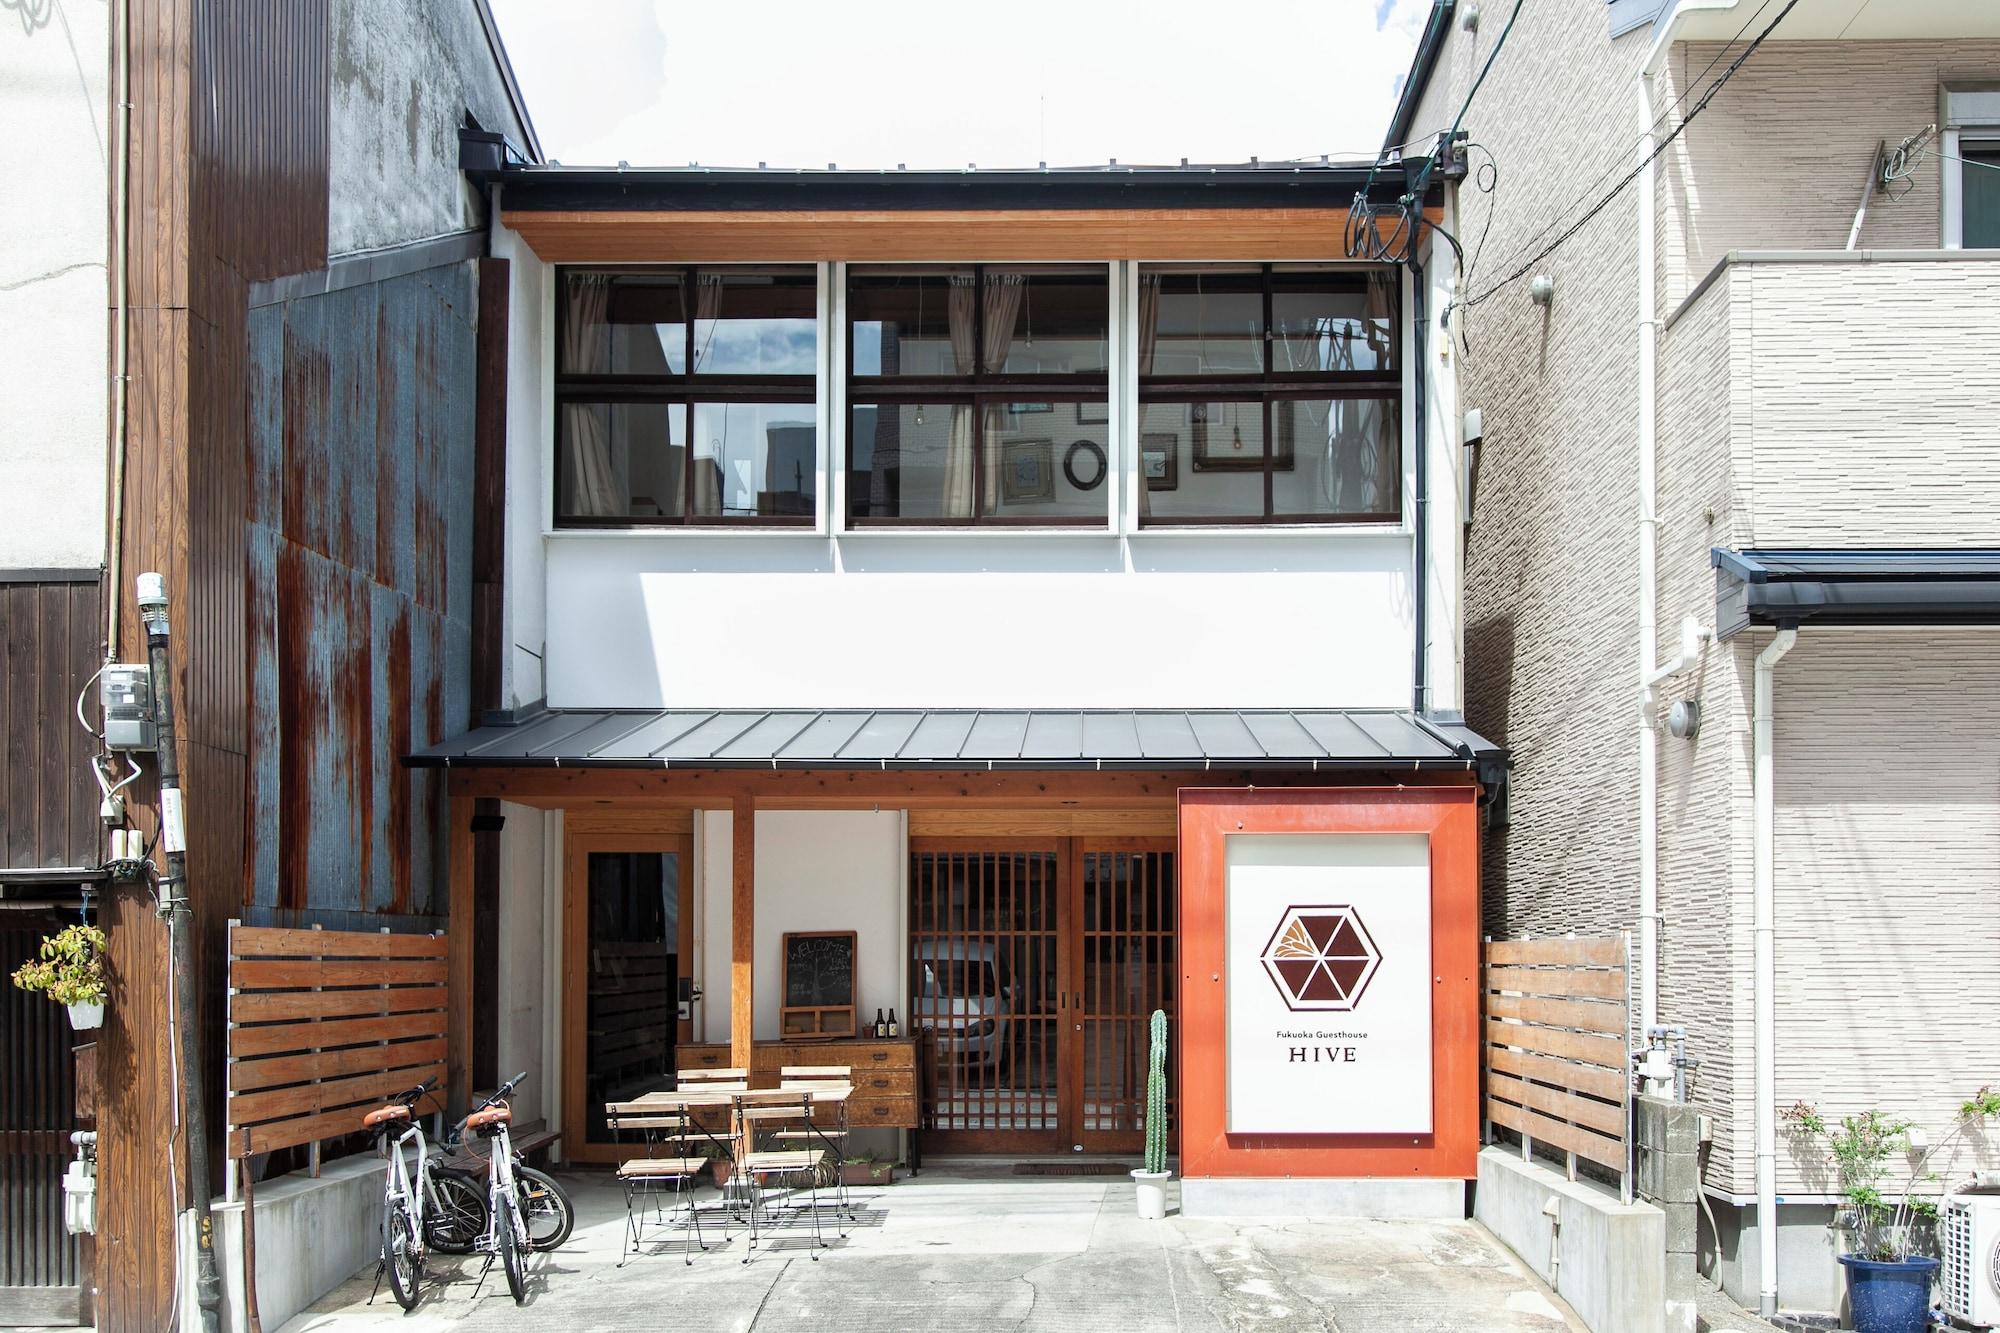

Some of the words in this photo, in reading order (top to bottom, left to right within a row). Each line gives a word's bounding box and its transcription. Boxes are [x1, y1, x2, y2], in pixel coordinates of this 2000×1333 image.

[788, 940, 846, 960] WELCOME
[1276, 1031, 1313, 1039] Fukuoka
[1316, 1030, 1368, 1039] Guesthouse
[1289, 1047, 1356, 1062] HIVE
